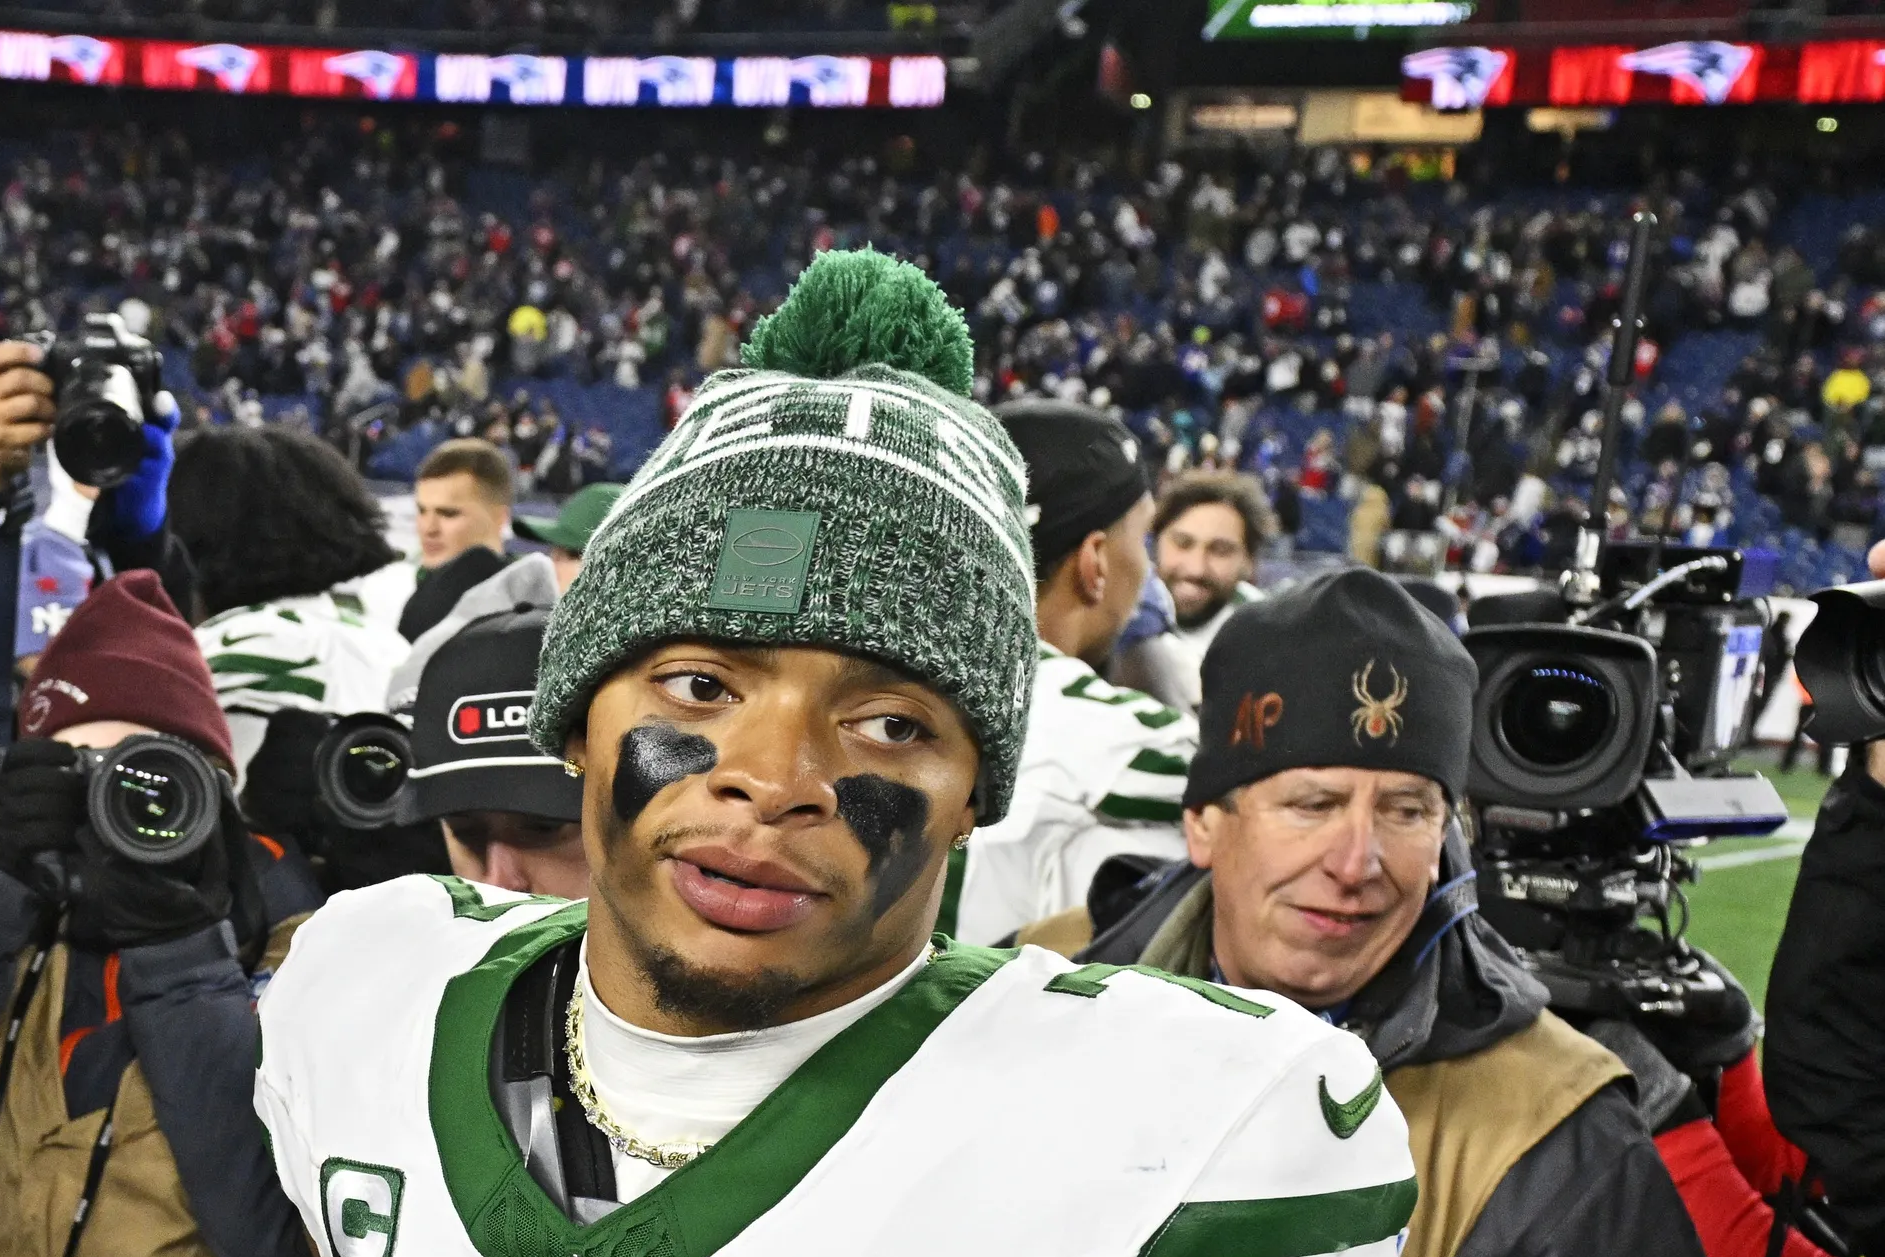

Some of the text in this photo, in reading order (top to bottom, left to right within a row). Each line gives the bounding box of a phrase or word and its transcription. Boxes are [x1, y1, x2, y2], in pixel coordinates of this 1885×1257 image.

[723, 574, 796, 585] NEW YORK
[720, 582, 795, 598] JETS
[1227, 690, 1284, 751] AP
